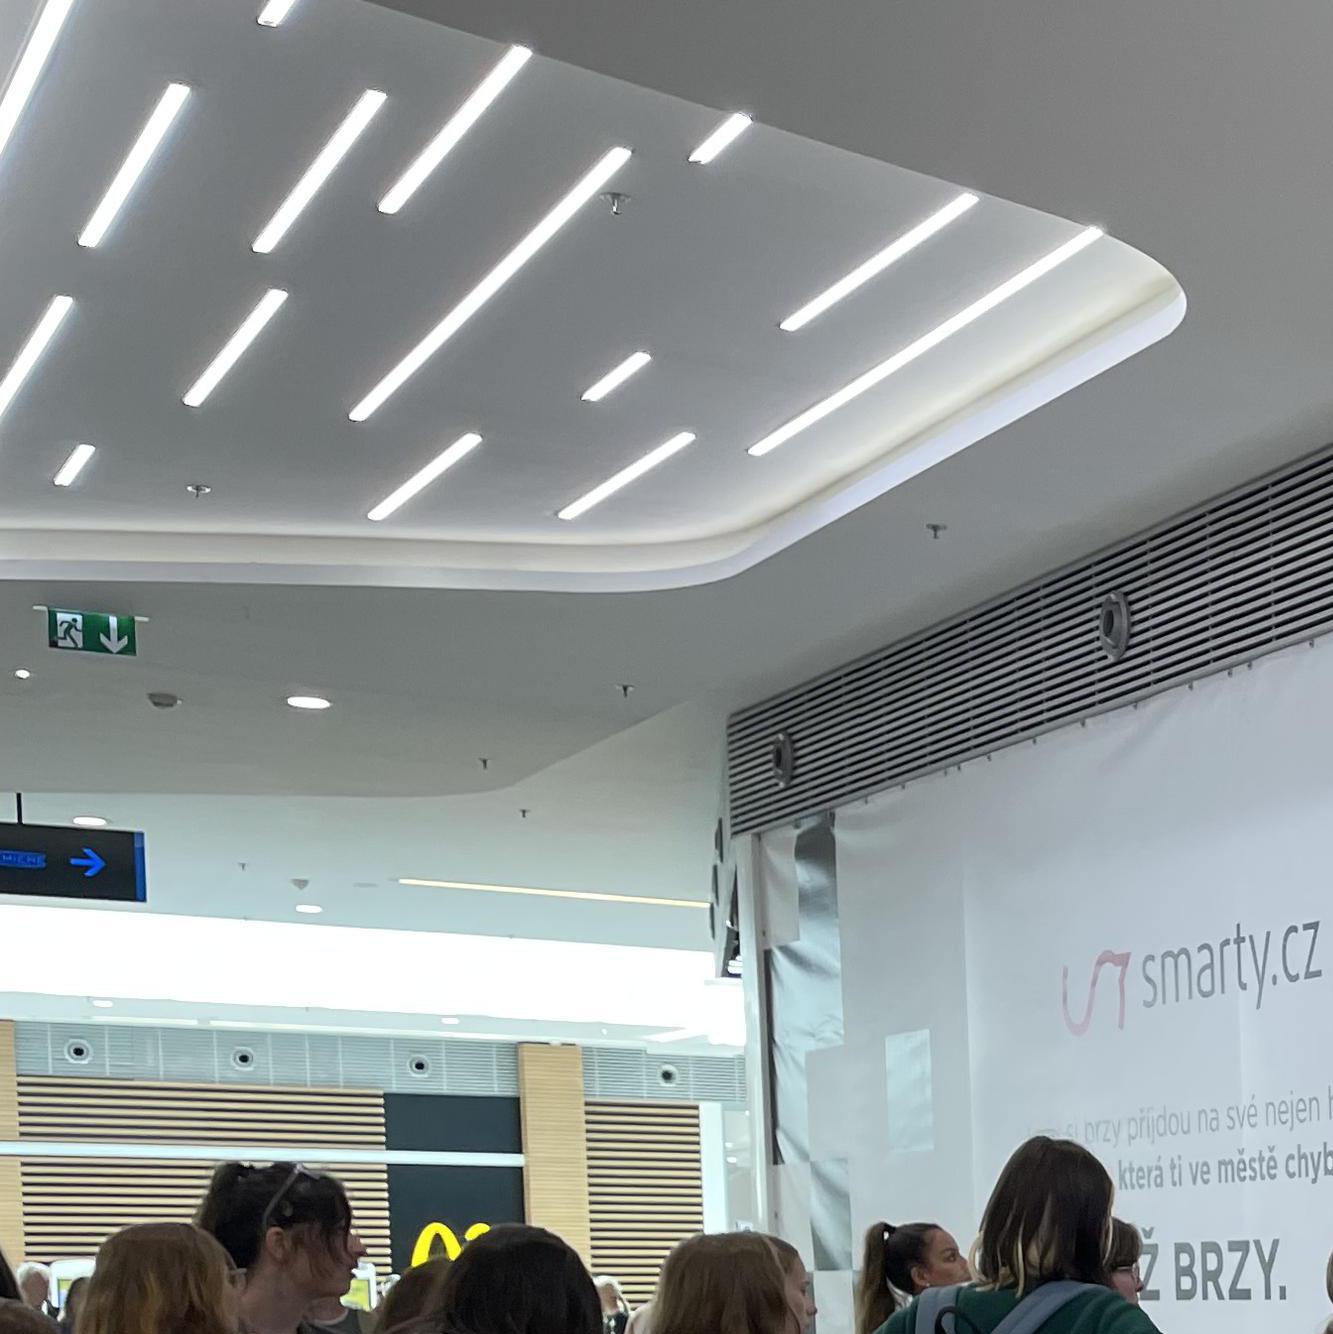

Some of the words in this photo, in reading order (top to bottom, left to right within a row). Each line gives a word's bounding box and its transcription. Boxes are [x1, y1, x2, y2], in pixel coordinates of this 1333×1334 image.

[1142, 921, 1323, 1010] smarty.cz
[1199, 1108, 1219, 1133] na
[1226, 1094, 1258, 1131] své
[1265, 1091, 1320, 1132] nejen
[1118, 1151, 1164, 1191] která
[1170, 1155, 1182, 1187] ti
[1190, 1161, 1210, 1186] ve
[1218, 1145, 1278, 1184] městě
[1139, 1227, 1161, 1301] Ž
[1174, 1238, 1287, 1301] BRZY.
